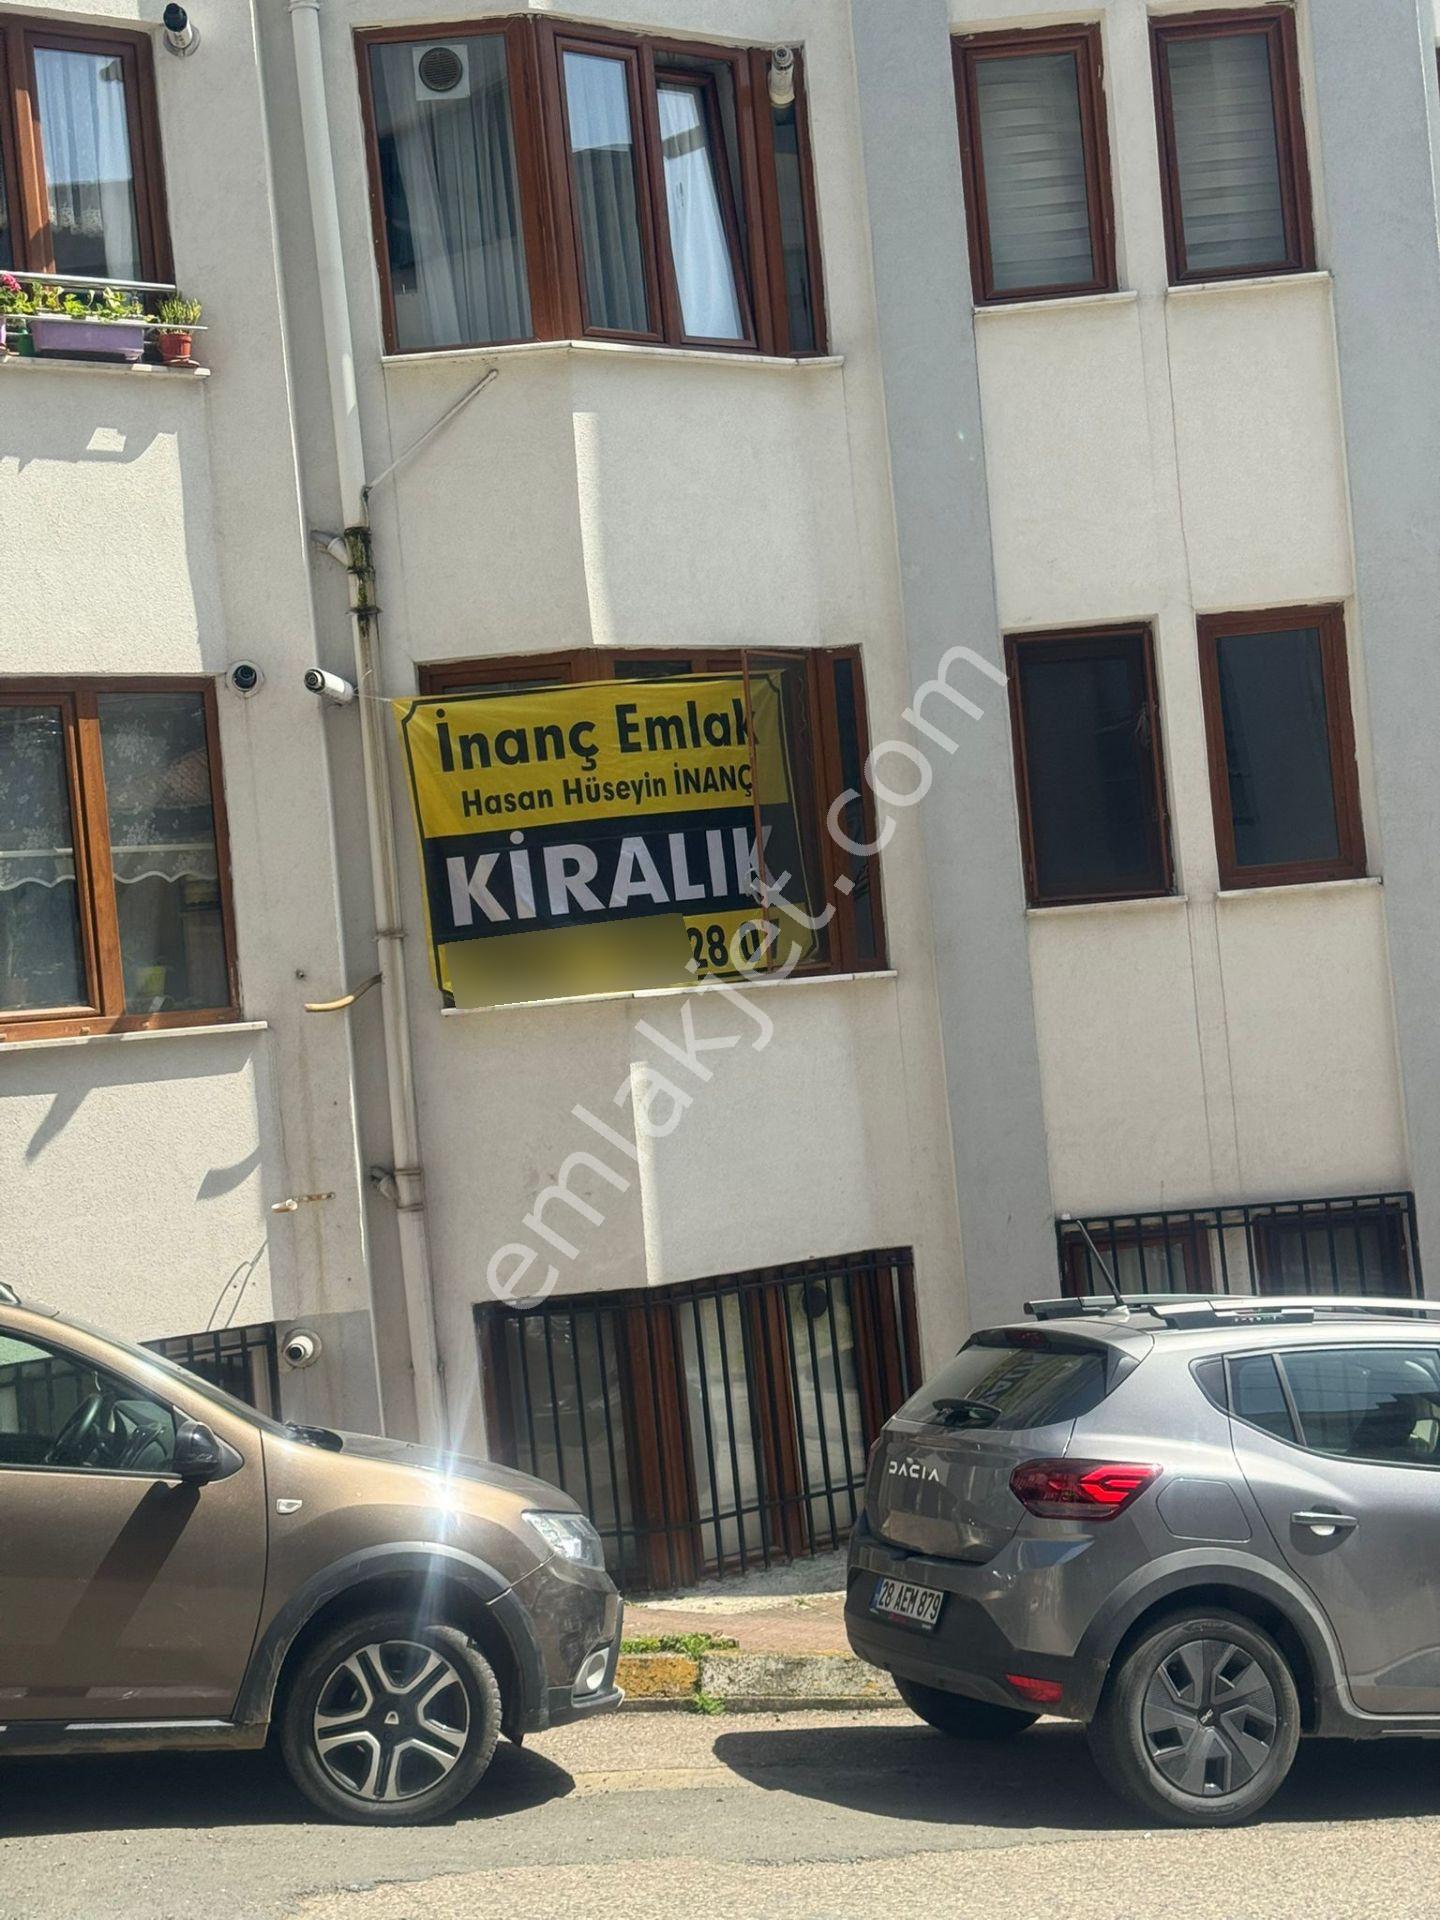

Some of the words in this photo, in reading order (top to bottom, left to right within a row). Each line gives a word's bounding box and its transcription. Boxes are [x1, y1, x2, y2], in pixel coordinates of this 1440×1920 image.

[436, 708, 599, 771] İnanç
[615, 698, 760, 755] Emlak
[462, 789, 553, 817] Hasan
[563, 772, 666, 805] Hüseyin
[674, 762, 753, 797] İNANÇ
[446, 825, 780, 927] KİRALIK
[889, 1460, 940, 1482] DACIA
[878, 1581, 895, 1608] 28
[893, 1585, 919, 1615] AEM
[916, 1590, 941, 1620] 879
